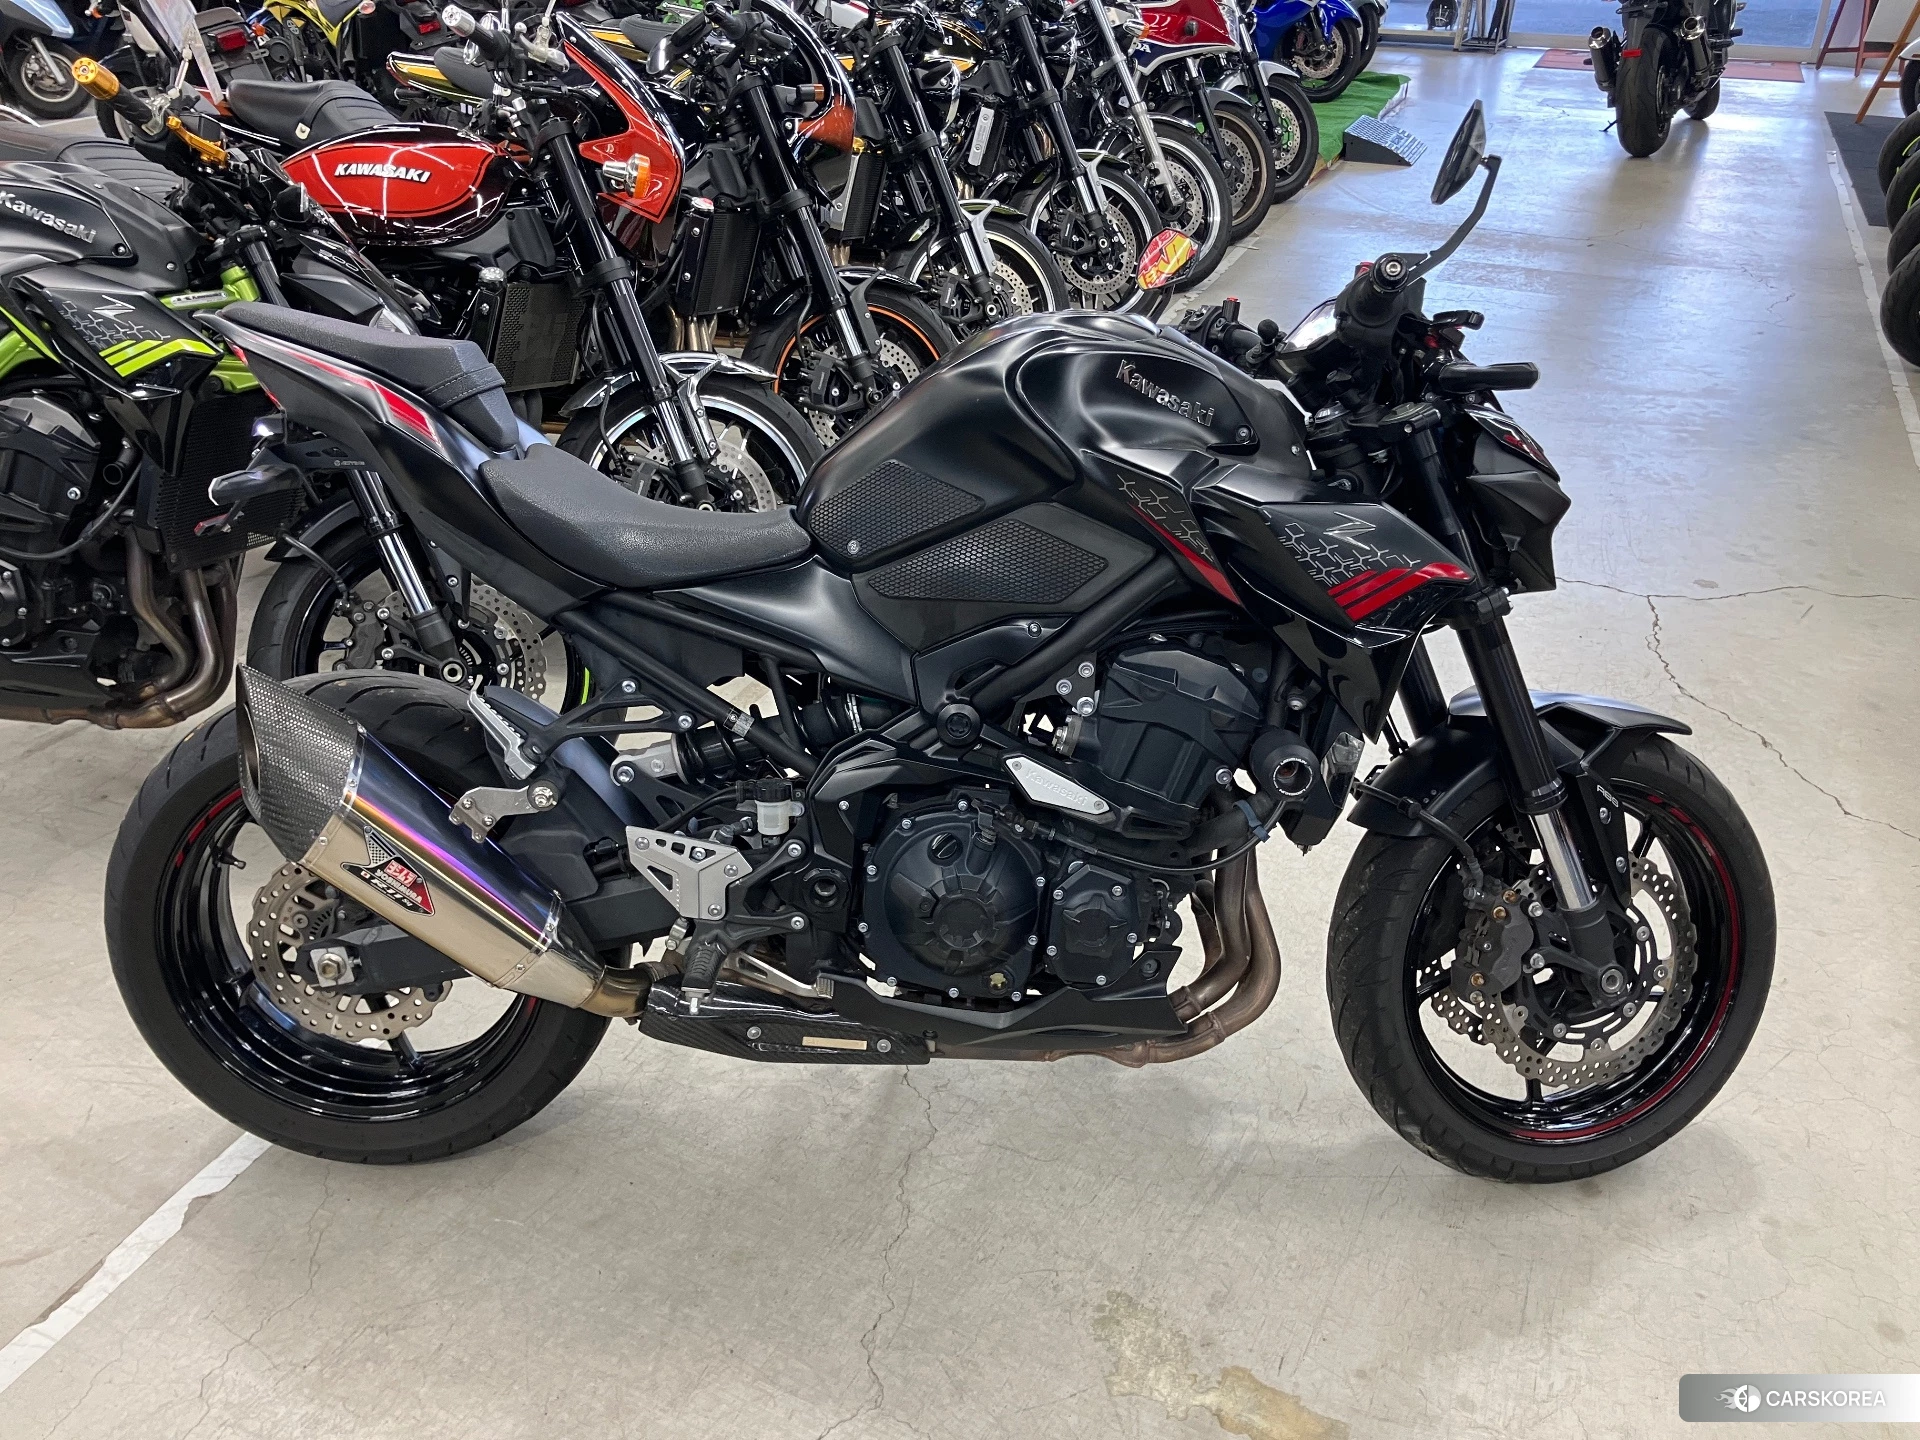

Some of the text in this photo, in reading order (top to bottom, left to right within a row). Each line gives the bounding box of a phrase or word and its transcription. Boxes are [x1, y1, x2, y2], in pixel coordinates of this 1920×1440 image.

[334, 163, 431, 183] KAWASAKI
[0, 190, 97, 244] Kawasaki
[1115, 358, 1215, 427] Kawasaki
[1025, 767, 1088, 806] Kawasaki
[374, 868, 423, 904] YOSHIMURA
